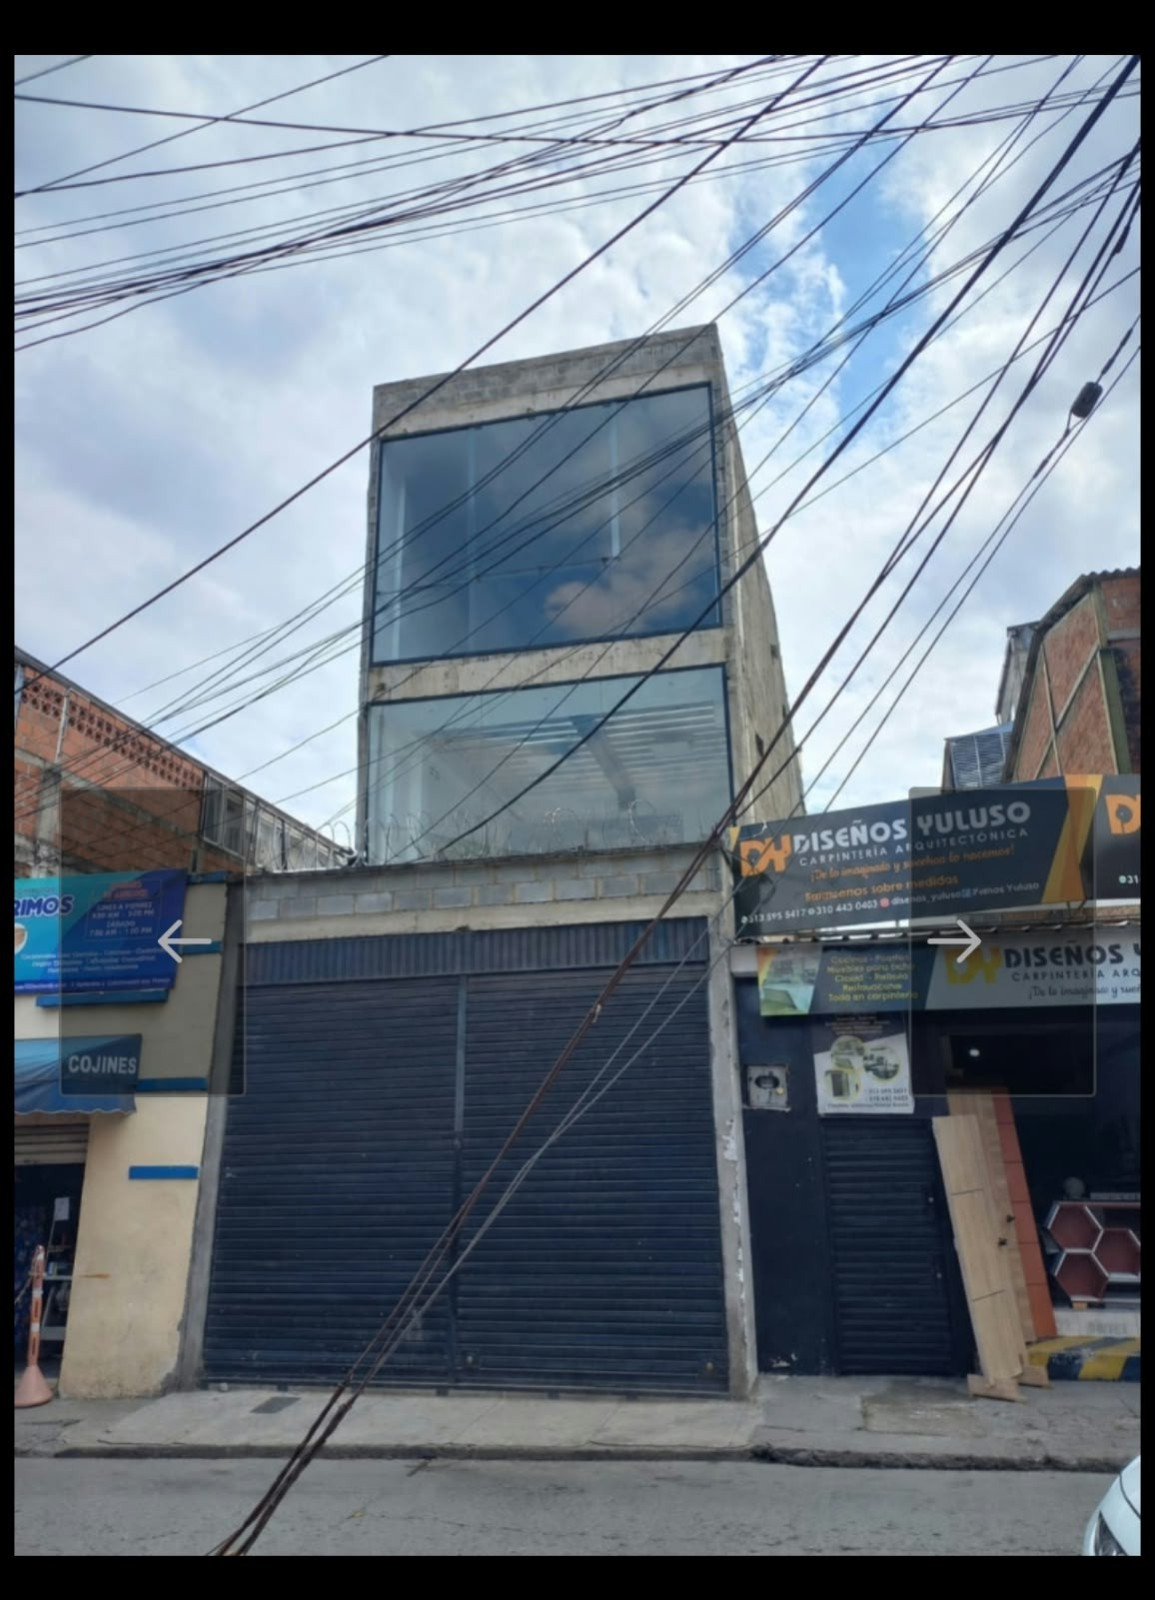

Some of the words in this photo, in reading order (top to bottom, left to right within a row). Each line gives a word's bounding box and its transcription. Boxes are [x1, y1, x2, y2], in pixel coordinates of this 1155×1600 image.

[1105, 794, 1141, 835] D
[793, 818, 908, 854] DISEÑOS
[917, 801, 1032, 837] YULUSO
[800, 846, 888, 867] CARPINTERÍA
[895, 827, 1029, 854] ARQUITECTÓNICA
[870, 880, 903, 895] sobre
[785, 908, 805, 920] 5417
[1004, 940, 1124, 968] DISEÑOS
[1011, 968, 1104, 983] CARPINTERÍA
[68, 1055, 138, 1075] COJINES
